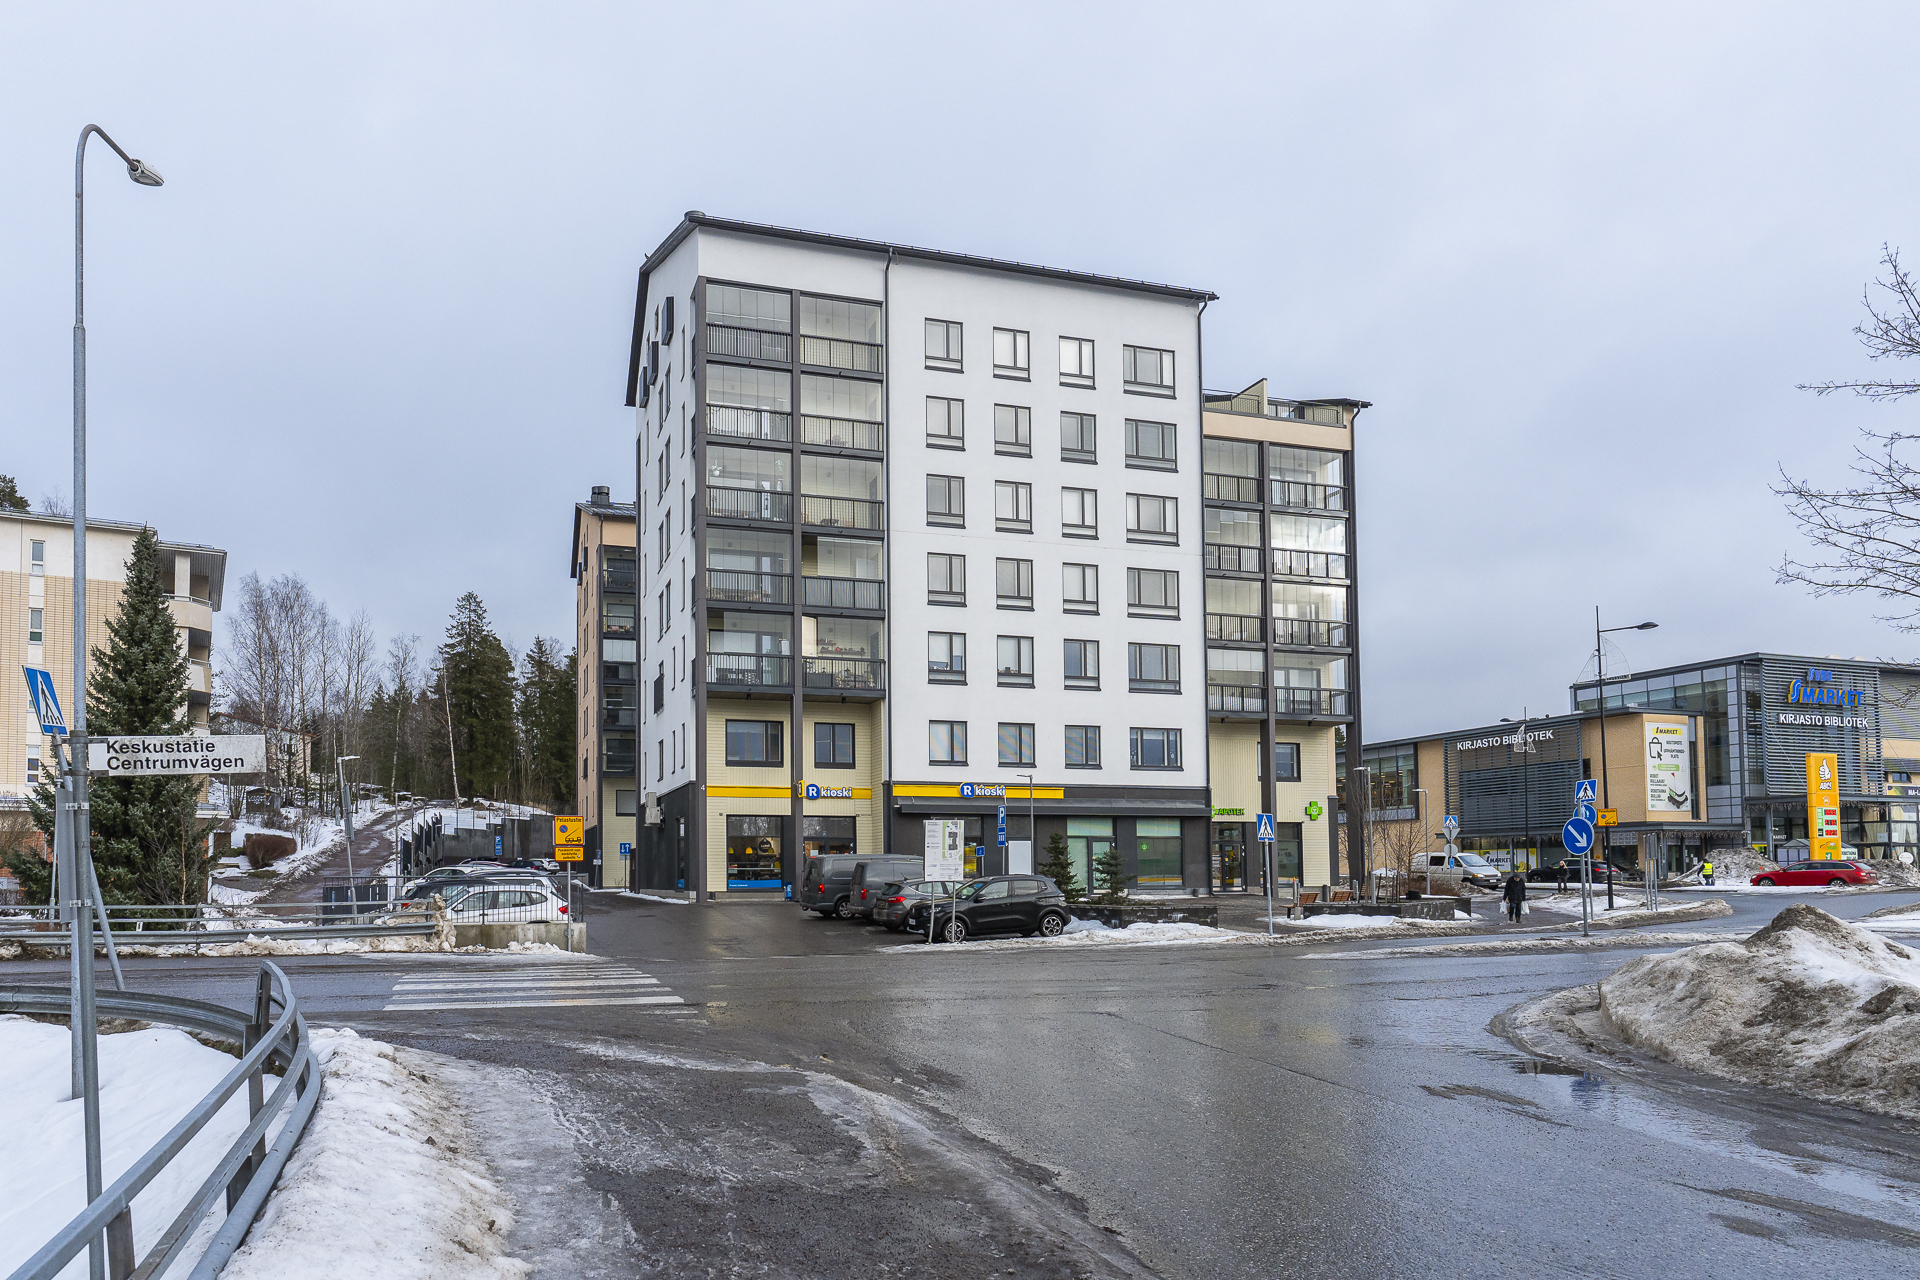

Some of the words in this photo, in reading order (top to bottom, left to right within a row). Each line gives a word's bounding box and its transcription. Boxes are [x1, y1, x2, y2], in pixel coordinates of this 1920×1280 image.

[1801, 687, 1863, 706] MARKET
[1779, 713, 1823, 726] KIRJASTO
[1824, 715, 1869, 728] BIBLIOTEK
[106, 739, 216, 754] Keskustatie
[1456, 737, 1500, 751] KIRJASTO
[1502, 729, 1554, 745] BIBLIOTEK
[107, 755, 245, 771] Centrumvägen
[808, 786, 817, 797] R
[820, 786, 852, 797] kioski
[963, 785, 972, 796] R
[975, 785, 1006, 796] kioski
